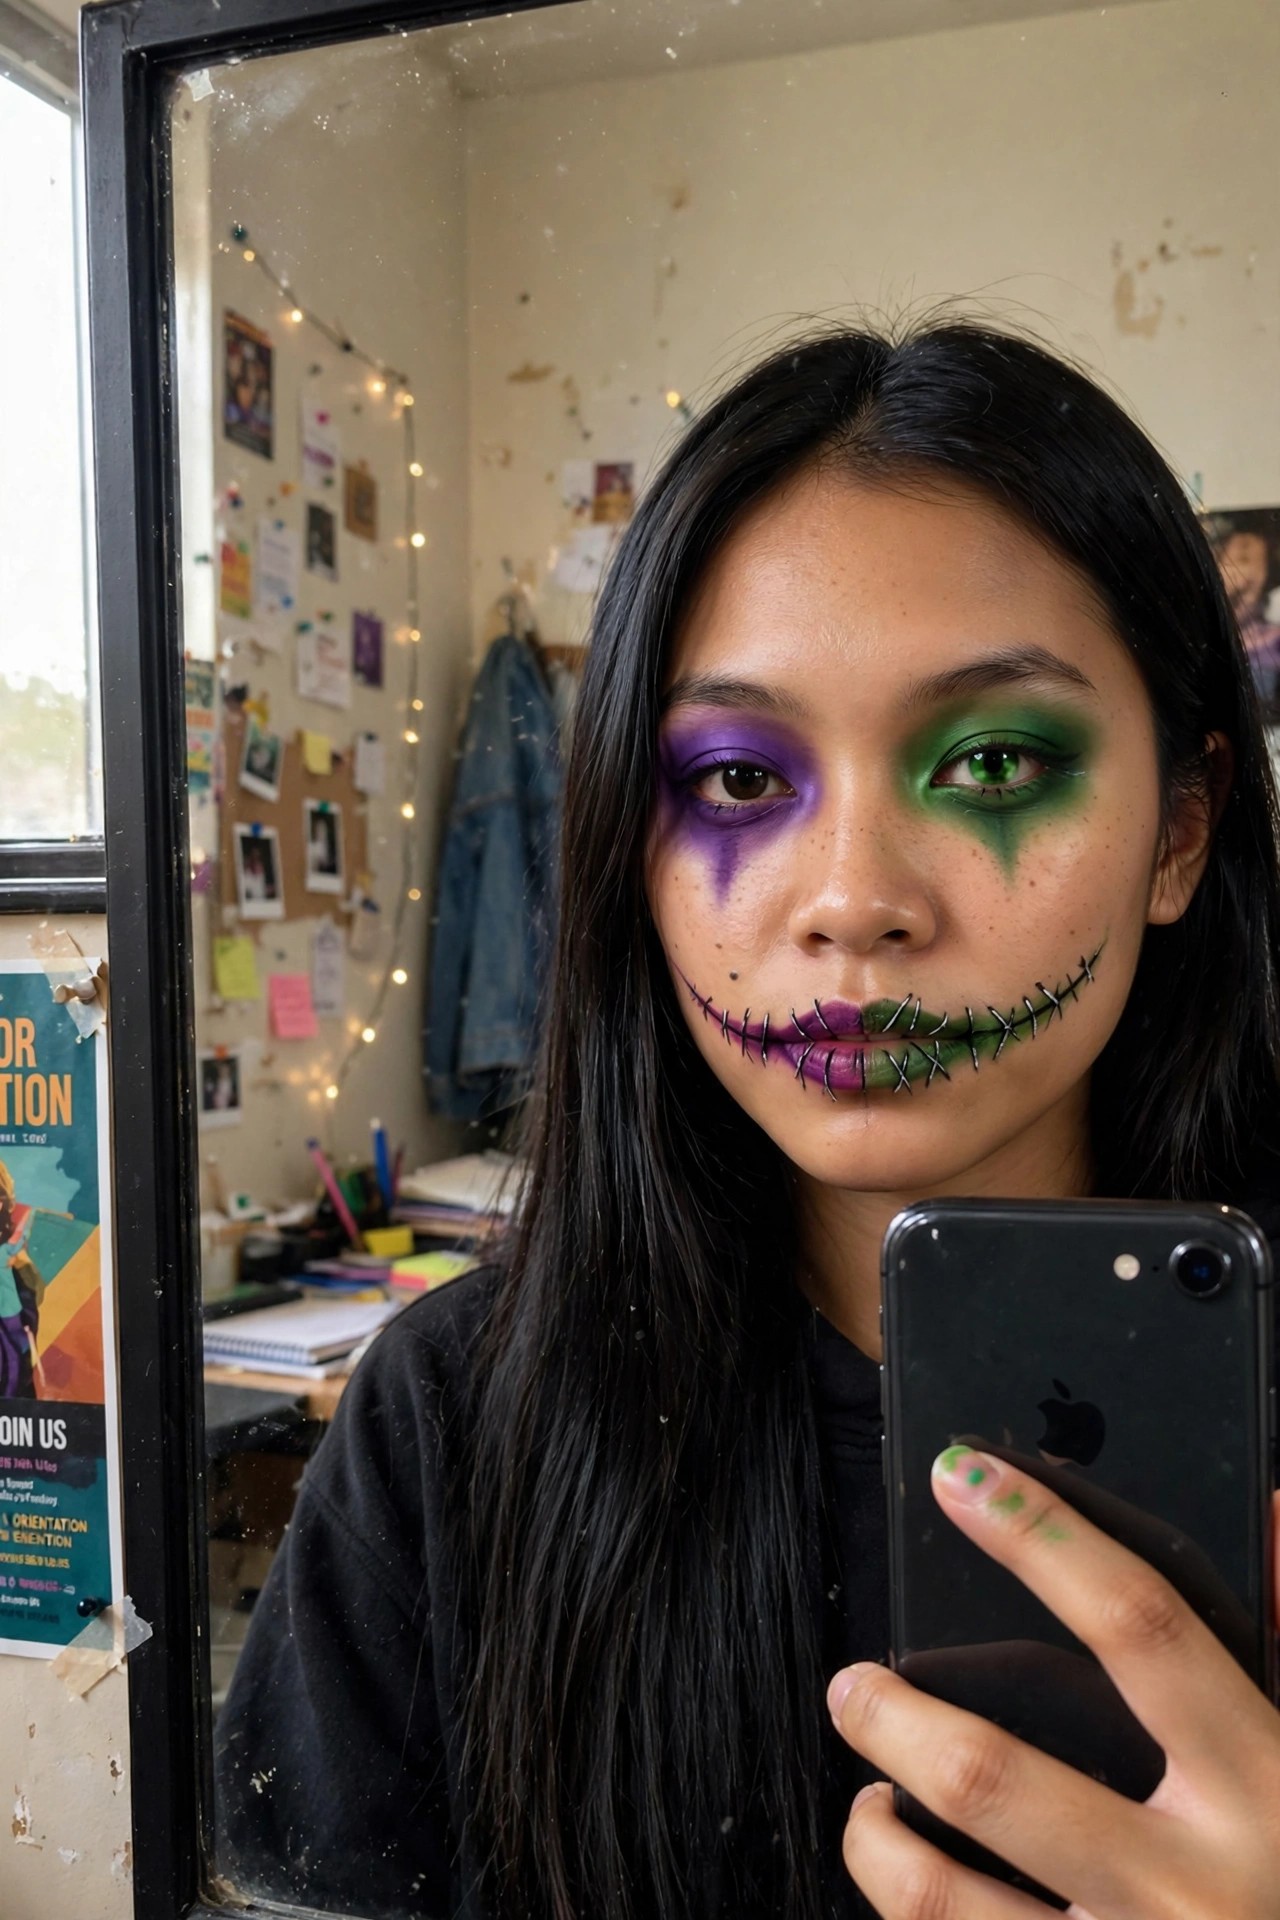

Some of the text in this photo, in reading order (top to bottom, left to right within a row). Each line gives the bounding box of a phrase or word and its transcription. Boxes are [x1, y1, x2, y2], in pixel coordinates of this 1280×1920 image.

[0, 1017, 37, 1068] OR
[0, 1073, 72, 1126] TION
[0, 1415, 67, 1450] OIN US
[12, 1512, 88, 1533] ORIENTATION
